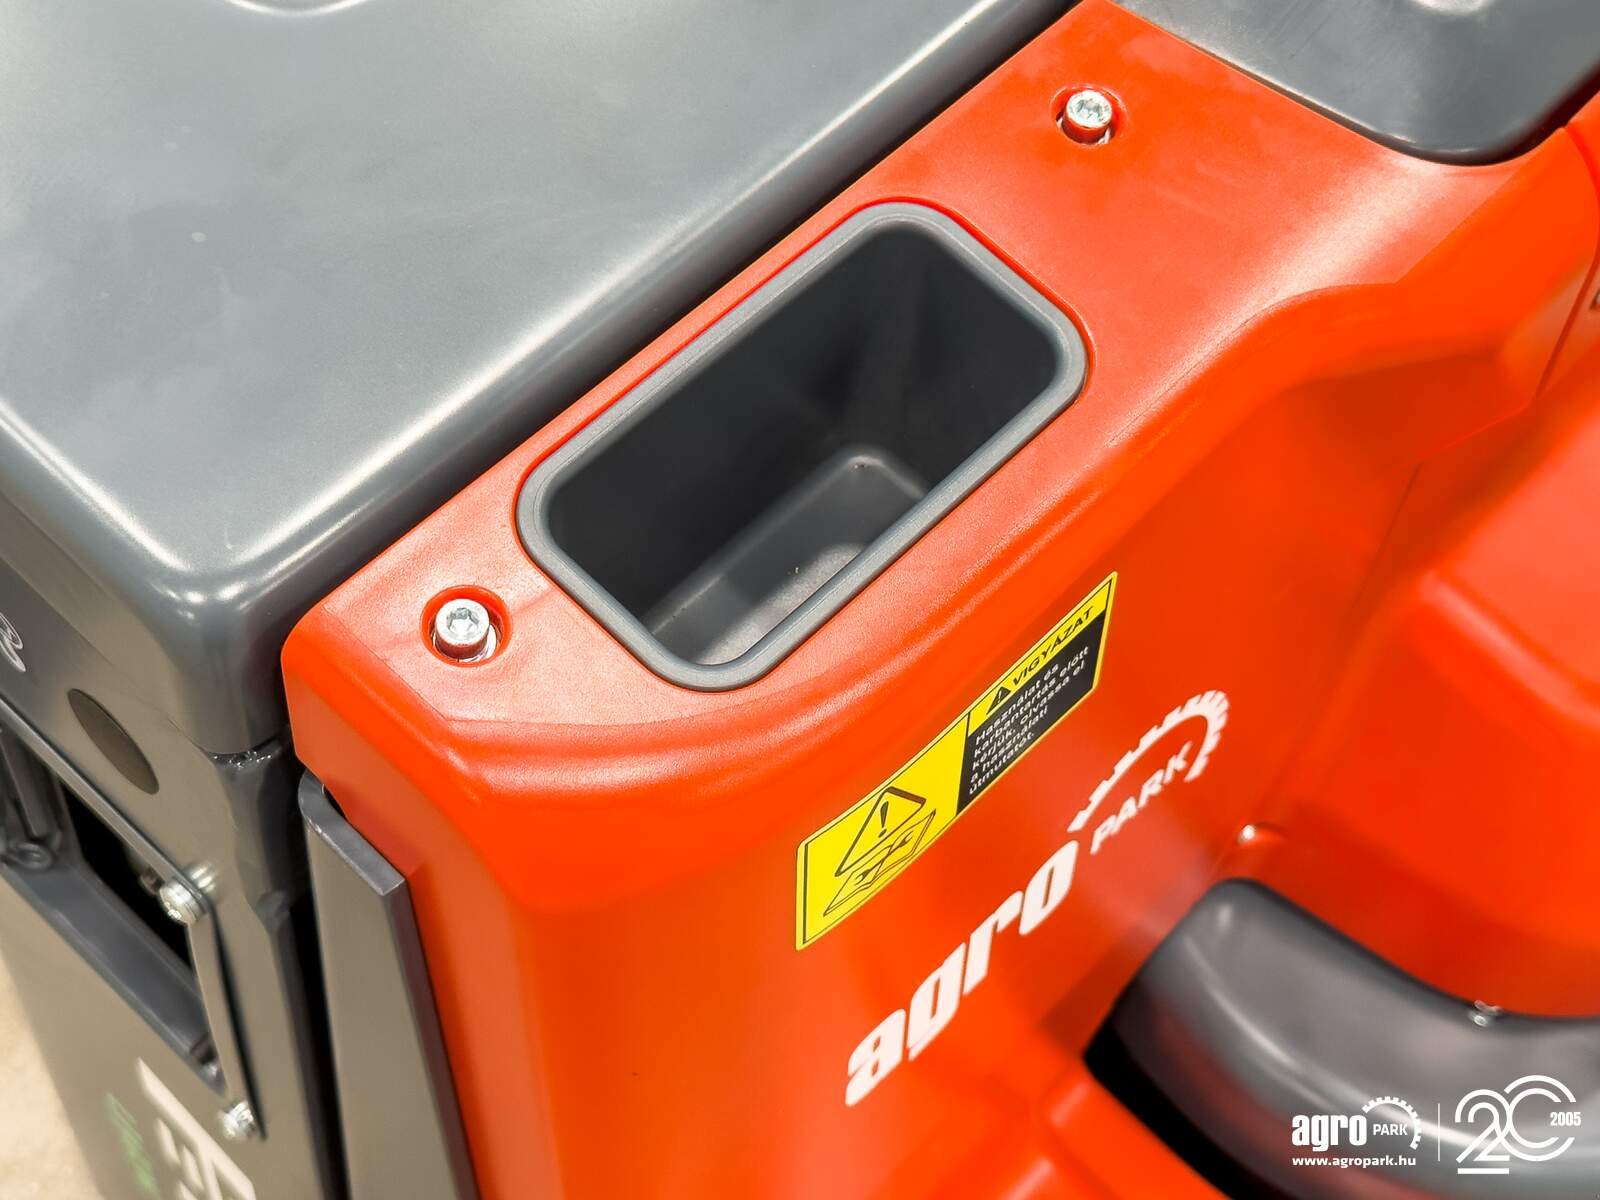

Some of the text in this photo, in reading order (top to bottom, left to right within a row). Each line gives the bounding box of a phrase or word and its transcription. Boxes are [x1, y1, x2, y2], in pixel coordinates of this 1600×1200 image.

[1012, 605, 1094, 686] VIGYÁZAT
[974, 676, 1056, 758] karbantartás
[975, 663, 1059, 746] Használat és
[1020, 678, 1070, 724] olvassa
[1073, 660, 1085, 676] el
[969, 733, 1034, 796] útmutatót.
[970, 707, 1048, 783] a használati
[845, 741, 1193, 1106] agro PARK
